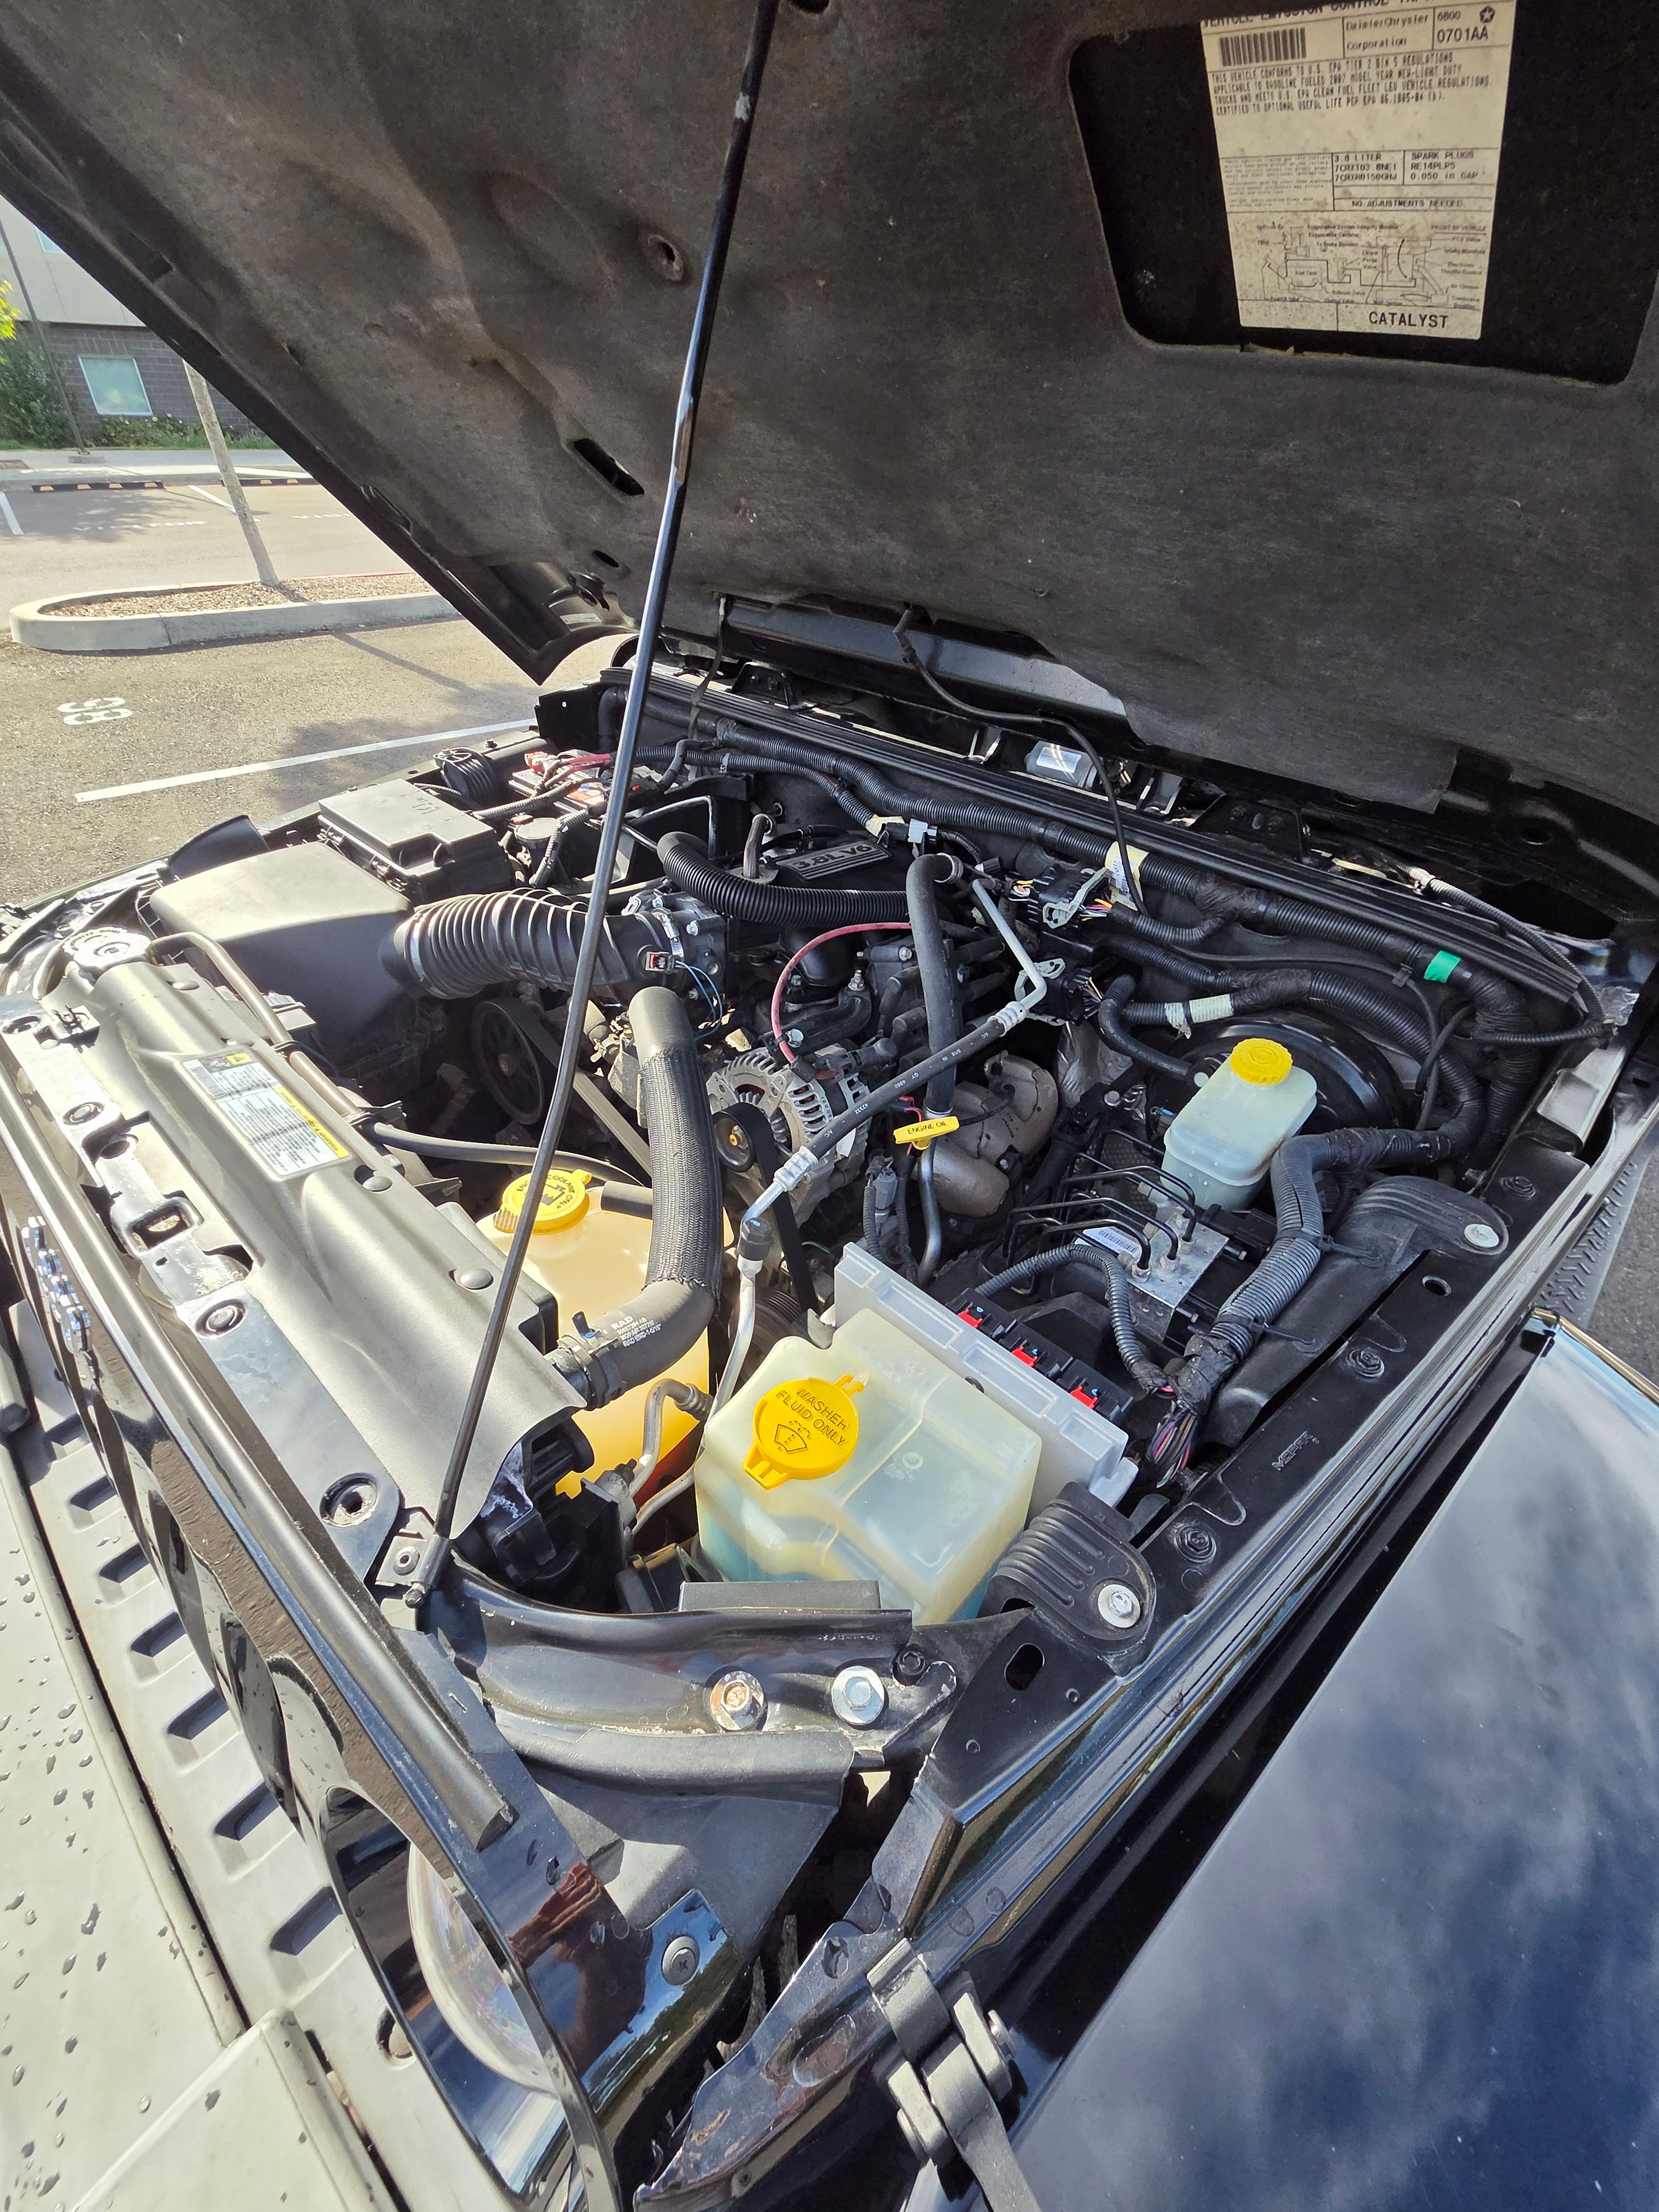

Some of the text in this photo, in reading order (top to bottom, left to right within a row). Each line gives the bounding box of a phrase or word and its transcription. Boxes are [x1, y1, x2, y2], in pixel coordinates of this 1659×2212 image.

[1437, 25, 1489, 43] 0701AA
[1347, 37, 1407, 51] Corporation
[1212, 52, 1453, 84] THIS VEHICLE CONFORMS TO U.S. EPA TIER 2 BIN 5 REGULATIONS
[1213, 82, 1250, 95] APPLICABLE
[1255, 81, 1262, 91] TO
[1265, 78, 1297, 91] GASOLINE
[1301, 76, 1325, 88] FUELED
[1350, 70, 1371, 83] MODEL
[1376, 67, 1393, 81] YEAR
[1443, 64, 1462, 76] DUTY
[1215, 93, 1237, 106] TRUCKS
[1240, 93, 1251, 103] AND
[1255, 90, 1274, 102] MEETS
[1278, 88, 1293, 100] U.S.
[1297, 87, 1310, 99] EPA
[1313, 85, 1334, 98] CLEAN
[1338, 83, 1354, 95] FUEL
[1359, 80, 1380, 93] FLEET
[1384, 79, 1397, 92] LEV
[1402, 77, 1432, 91] VEHICLE
[1216, 103, 1249, 117] CERTIFIED
[1253, 103, 1261, 113] TO
[1264, 100, 1294, 113] OPTIONAL
[1298, 98, 1322, 111] USEFUL
[1326, 96, 1342, 109] LIFE
[1363, 93, 1376, 106] EPA
[1354, 153, 1381, 161] LITER
[1366, 199, 1425, 207] ADJUSTMENTS
[1429, 199, 1464, 208] NEEDED
[1369, 311, 1449, 329] CATALYST
[793, 844, 873, 869] 3.8L V6
[854, 1102, 868, 1115] 42332
[907, 1123, 935, 1135] ENGINE
[556, 1194, 573, 1209] ONLY
[611, 1316, 633, 1330] RAD
[775, 1389, 846, 1446] FLUID ONLY
[796, 1387, 848, 1431] WASHER
[1271, 1431, 1314, 1471] MOPAR
